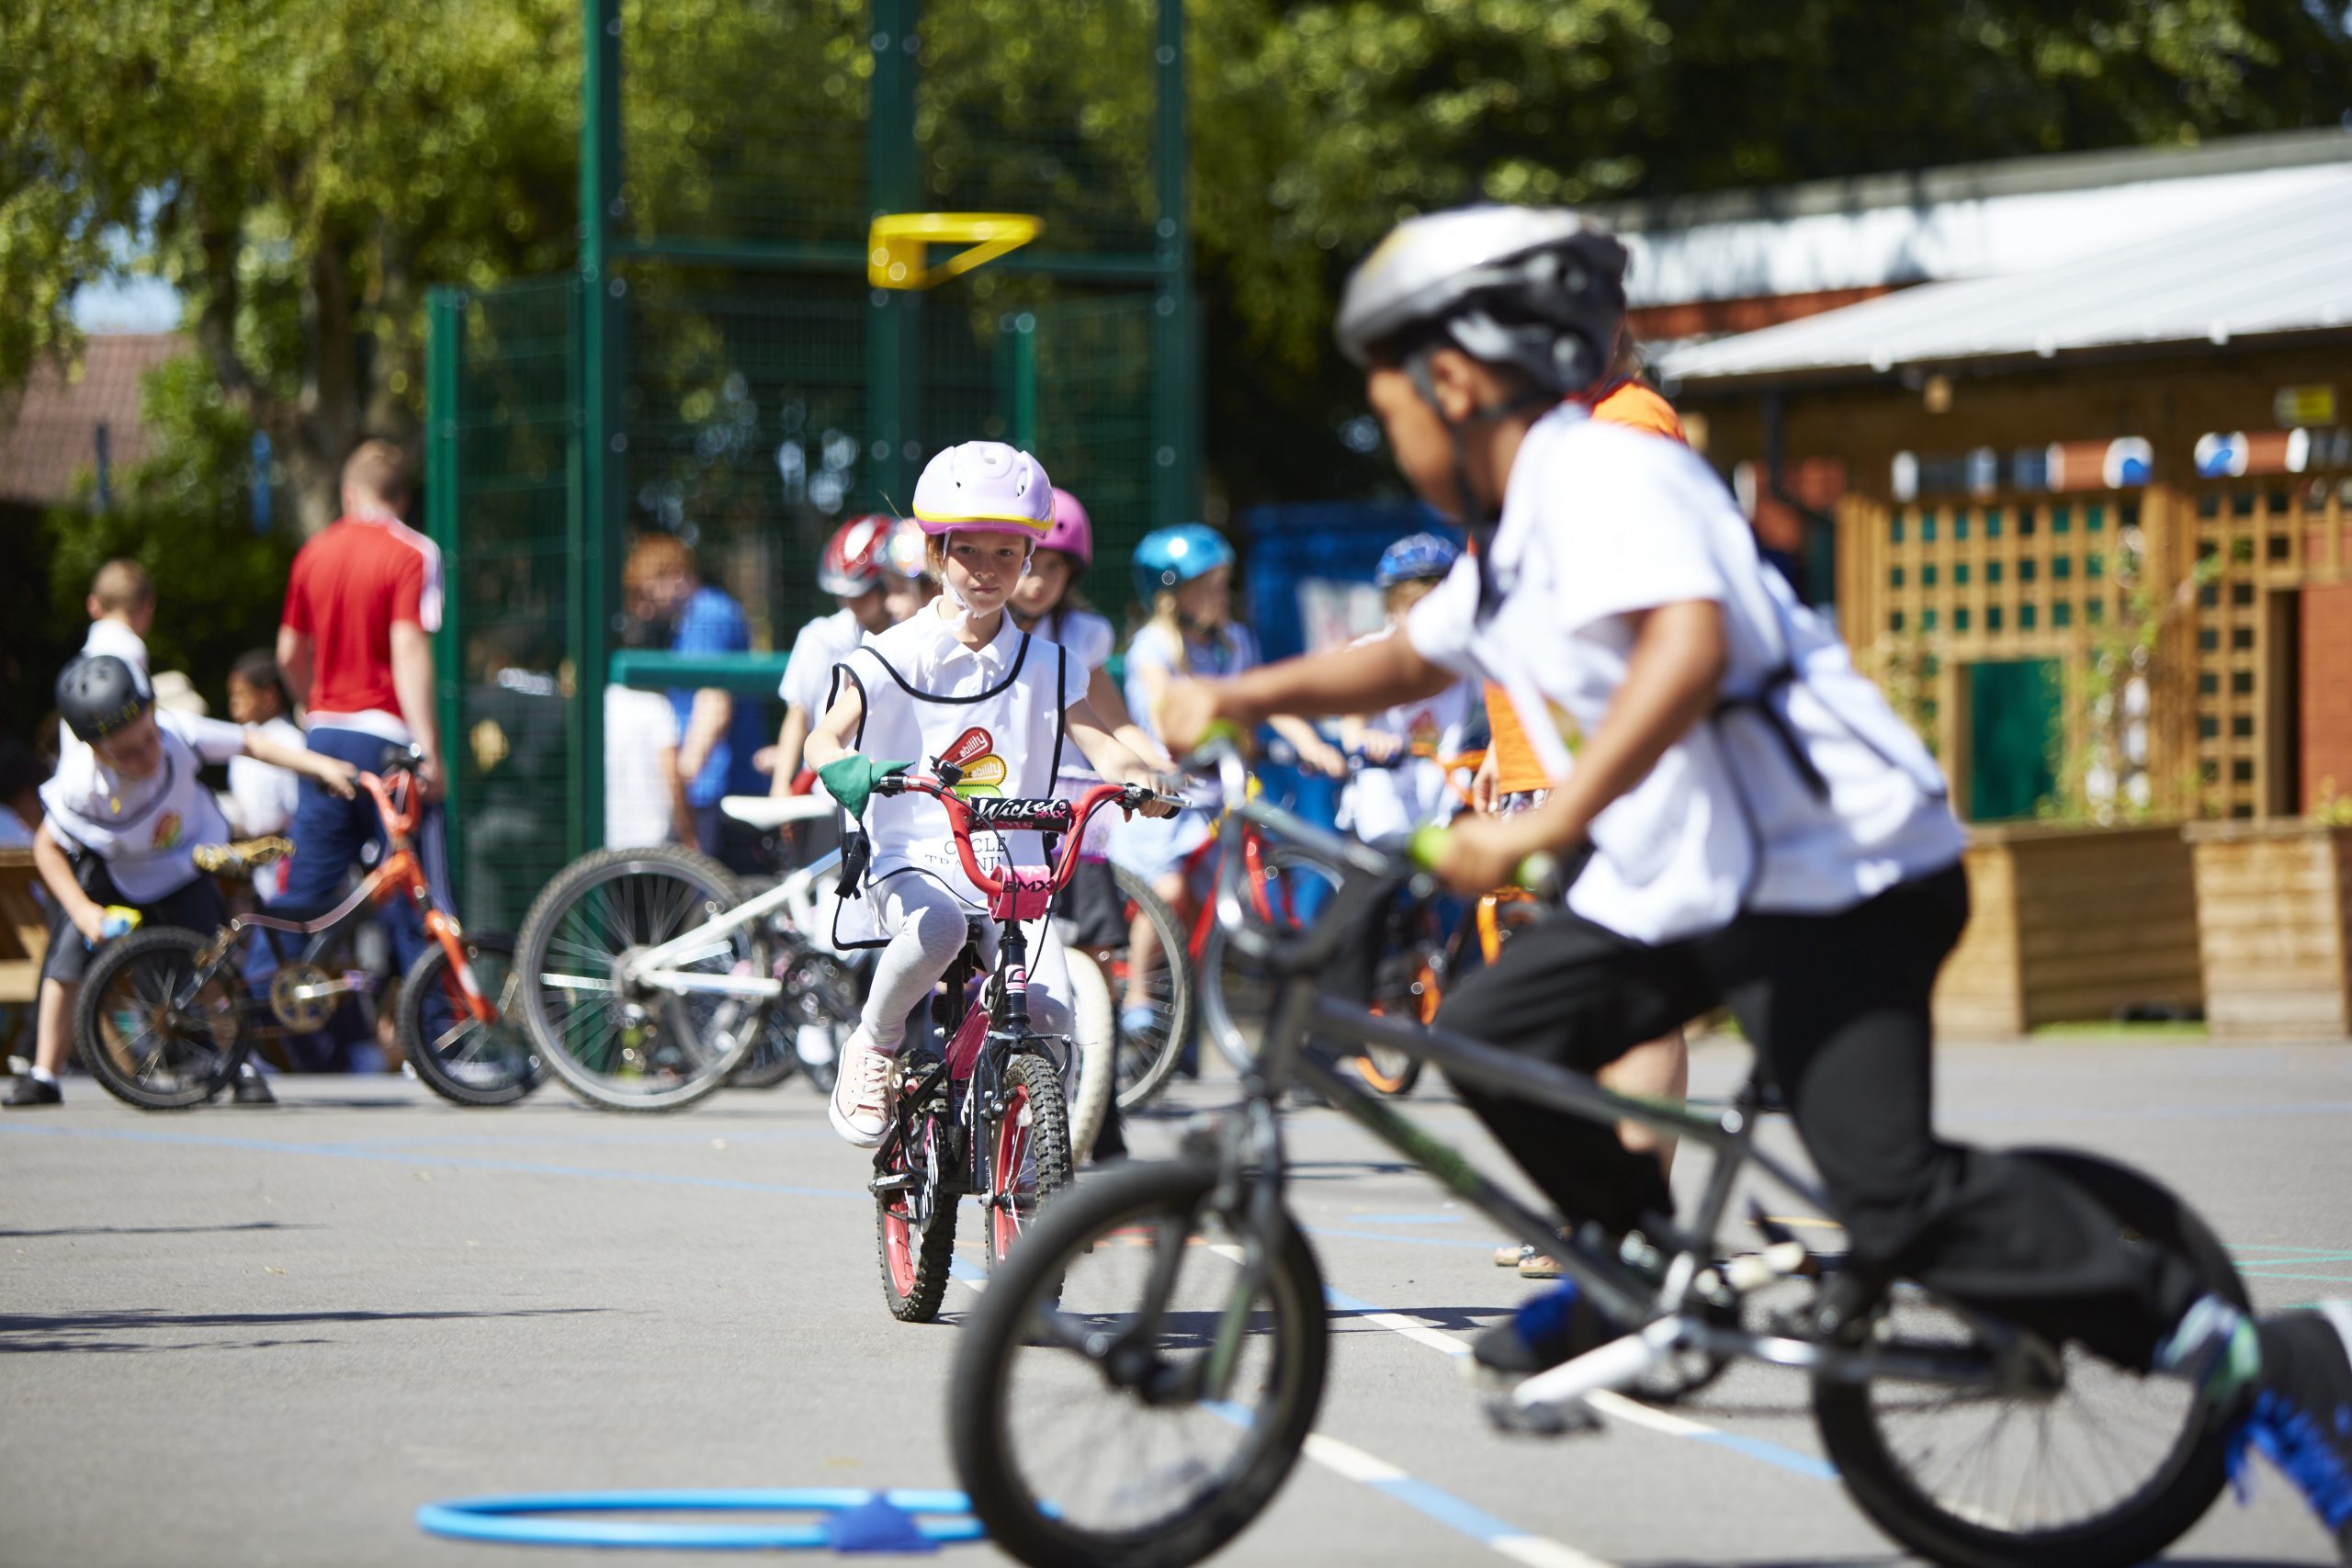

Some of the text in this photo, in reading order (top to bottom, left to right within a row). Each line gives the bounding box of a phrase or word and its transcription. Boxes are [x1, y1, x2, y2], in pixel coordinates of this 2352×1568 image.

[960, 761, 1002, 782] ikeability
[975, 798, 1061, 820] Wicked
[944, 837, 1006, 854] CCLE
[1002, 879, 1051, 893] BMX
